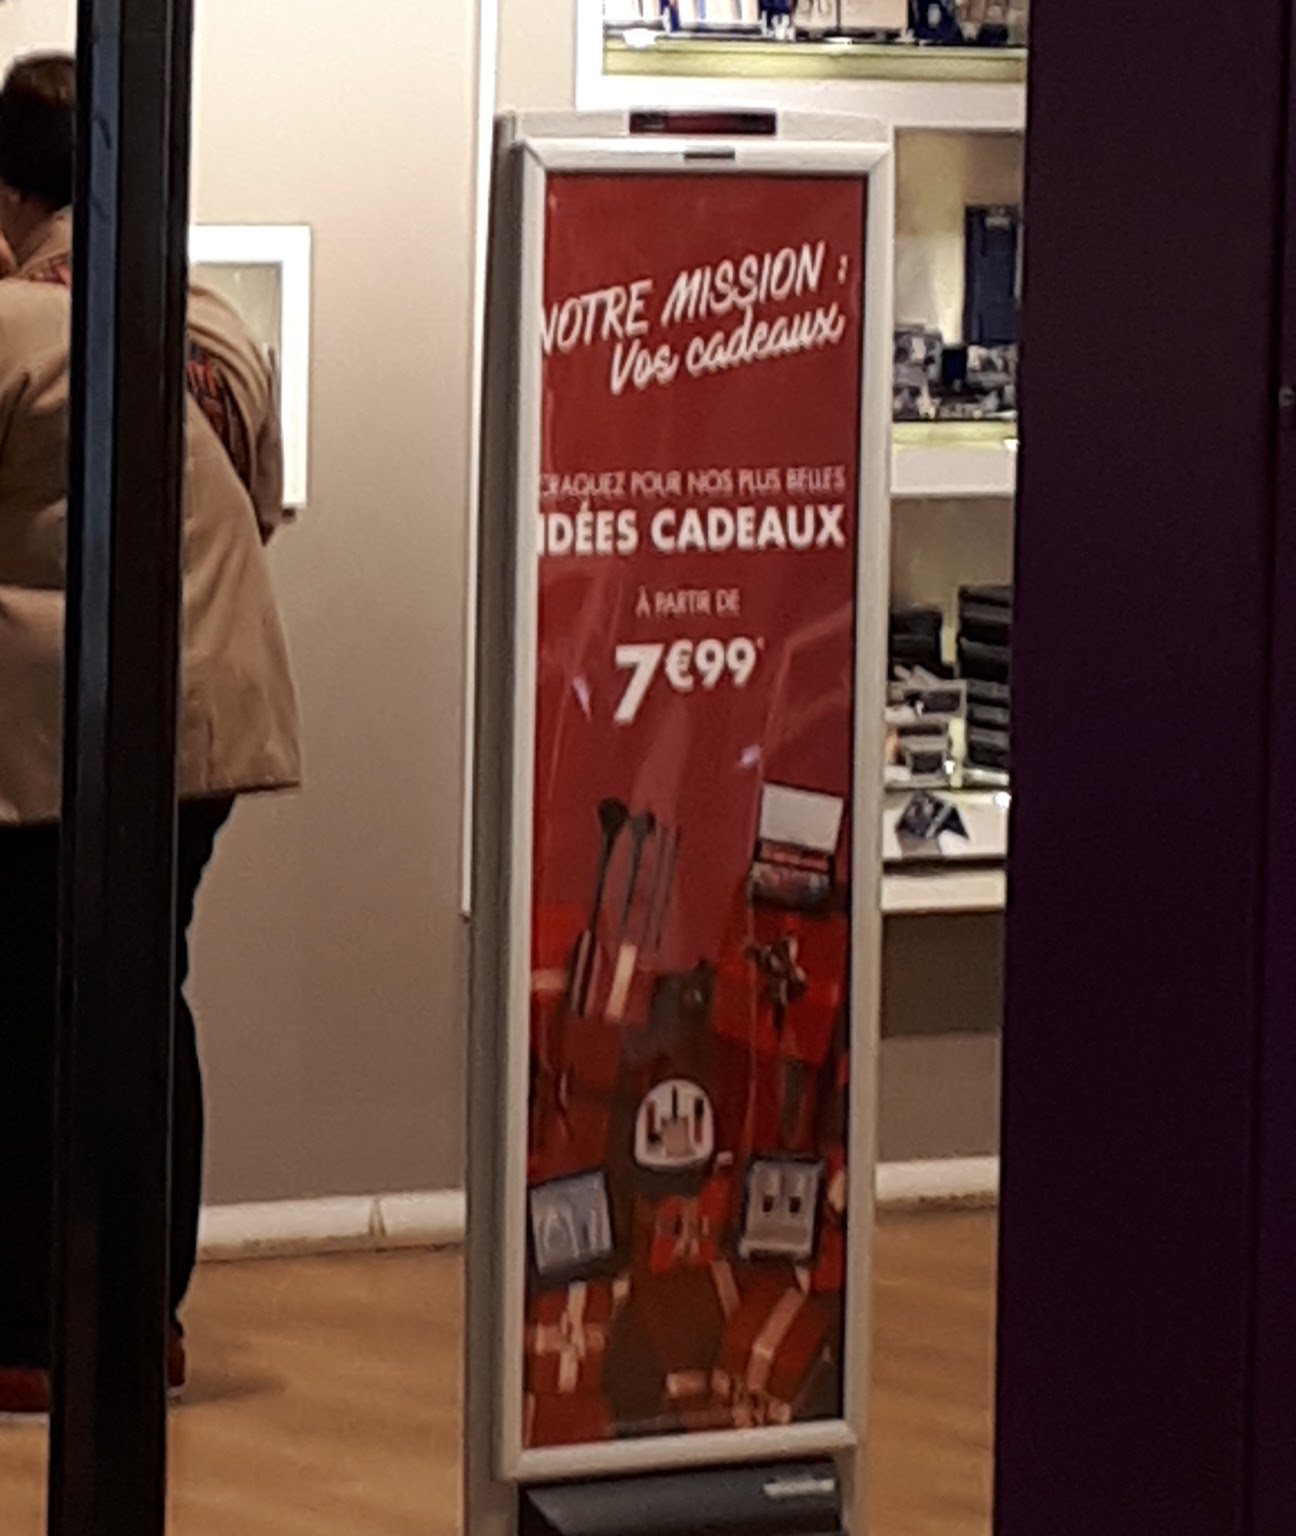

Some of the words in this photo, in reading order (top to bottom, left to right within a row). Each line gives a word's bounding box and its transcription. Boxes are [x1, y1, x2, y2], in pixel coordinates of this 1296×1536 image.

[540, 278, 653, 356] NOTRE
[661, 239, 826, 328] MISSION
[610, 337, 680, 396] Vos
[685, 301, 846, 378] cadeaux
[630, 469, 683, 497] POUR
[687, 468, 733, 496] NOS
[738, 466, 782, 493] PLUS
[785, 465, 847, 492] BELLES
[537, 499, 640, 557] IDÉES
[650, 503, 847, 553] CADEAUX
[655, 589, 711, 616] PARTIR
[716, 587, 740, 616] DE
